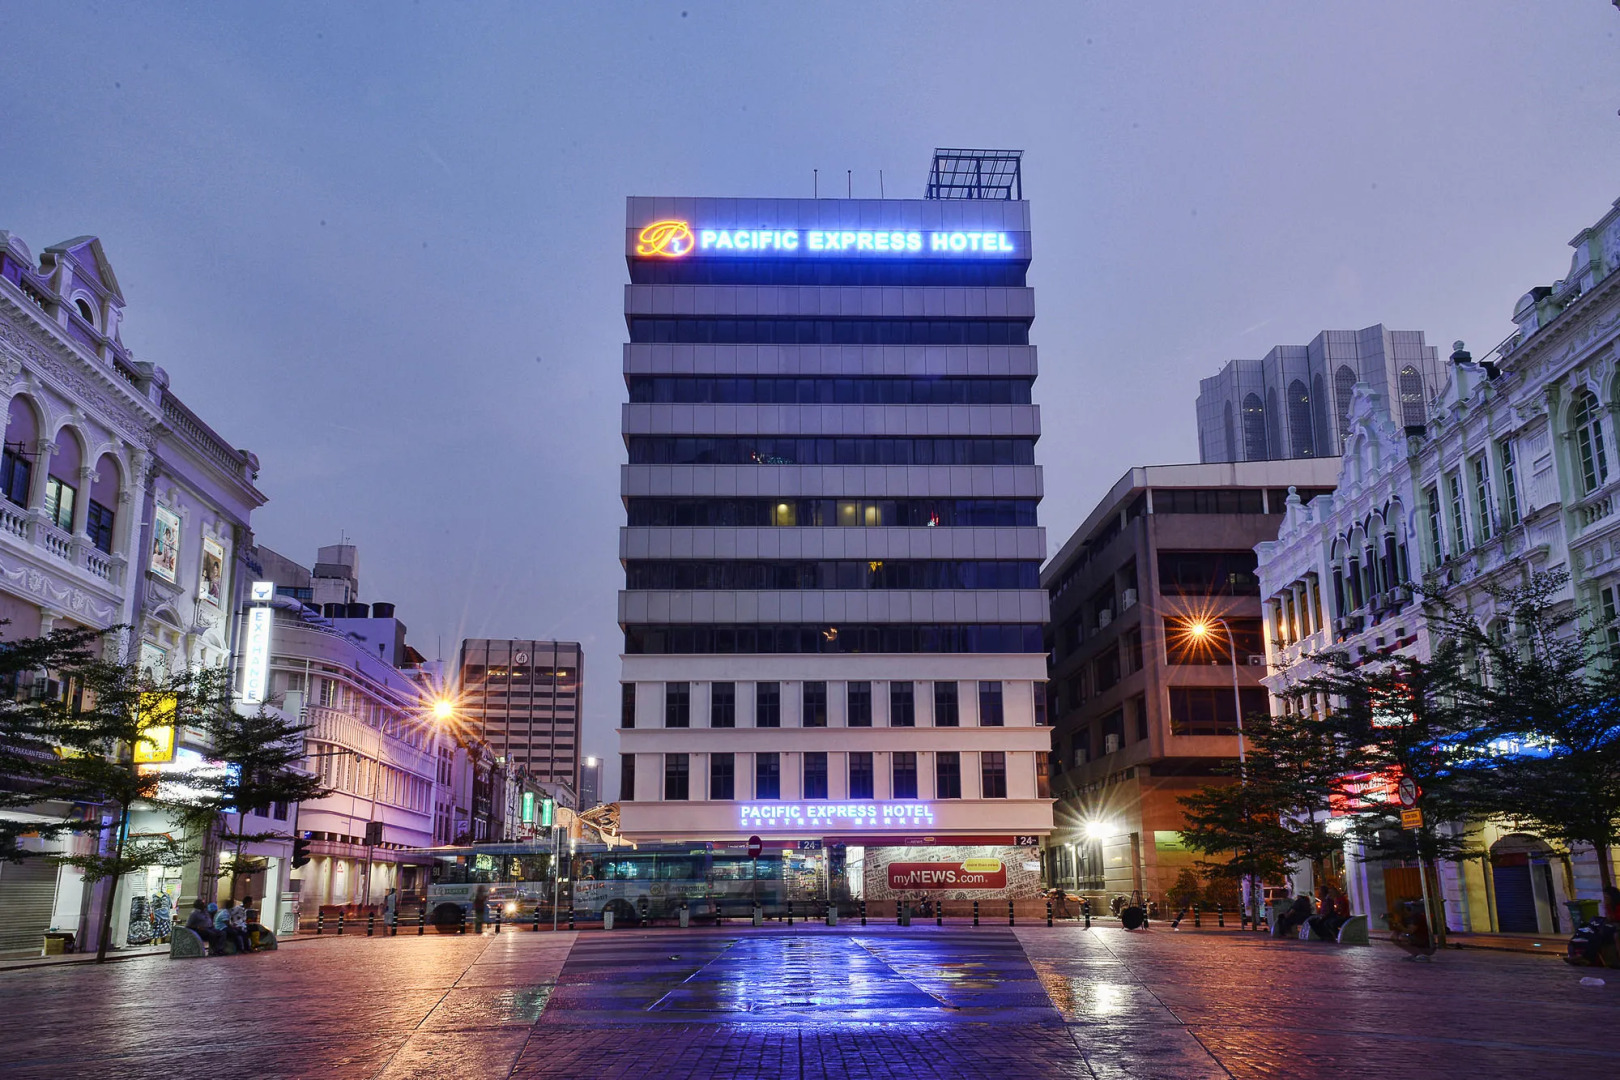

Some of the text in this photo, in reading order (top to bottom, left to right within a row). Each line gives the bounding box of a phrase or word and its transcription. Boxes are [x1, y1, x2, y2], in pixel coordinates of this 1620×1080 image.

[701, 230, 1014, 252] PACIFIC EXPRESS HOTEL
[248, 611, 263, 700] EXCHANGE
[741, 804, 935, 818] PACIFIC EXPRESS HOTEL
[741, 818, 934, 827] CENTRAL MARKET
[803, 841, 815, 849] 24
[1020, 836, 1032, 845] 24
[893, 870, 984, 885] myNEWS.com
